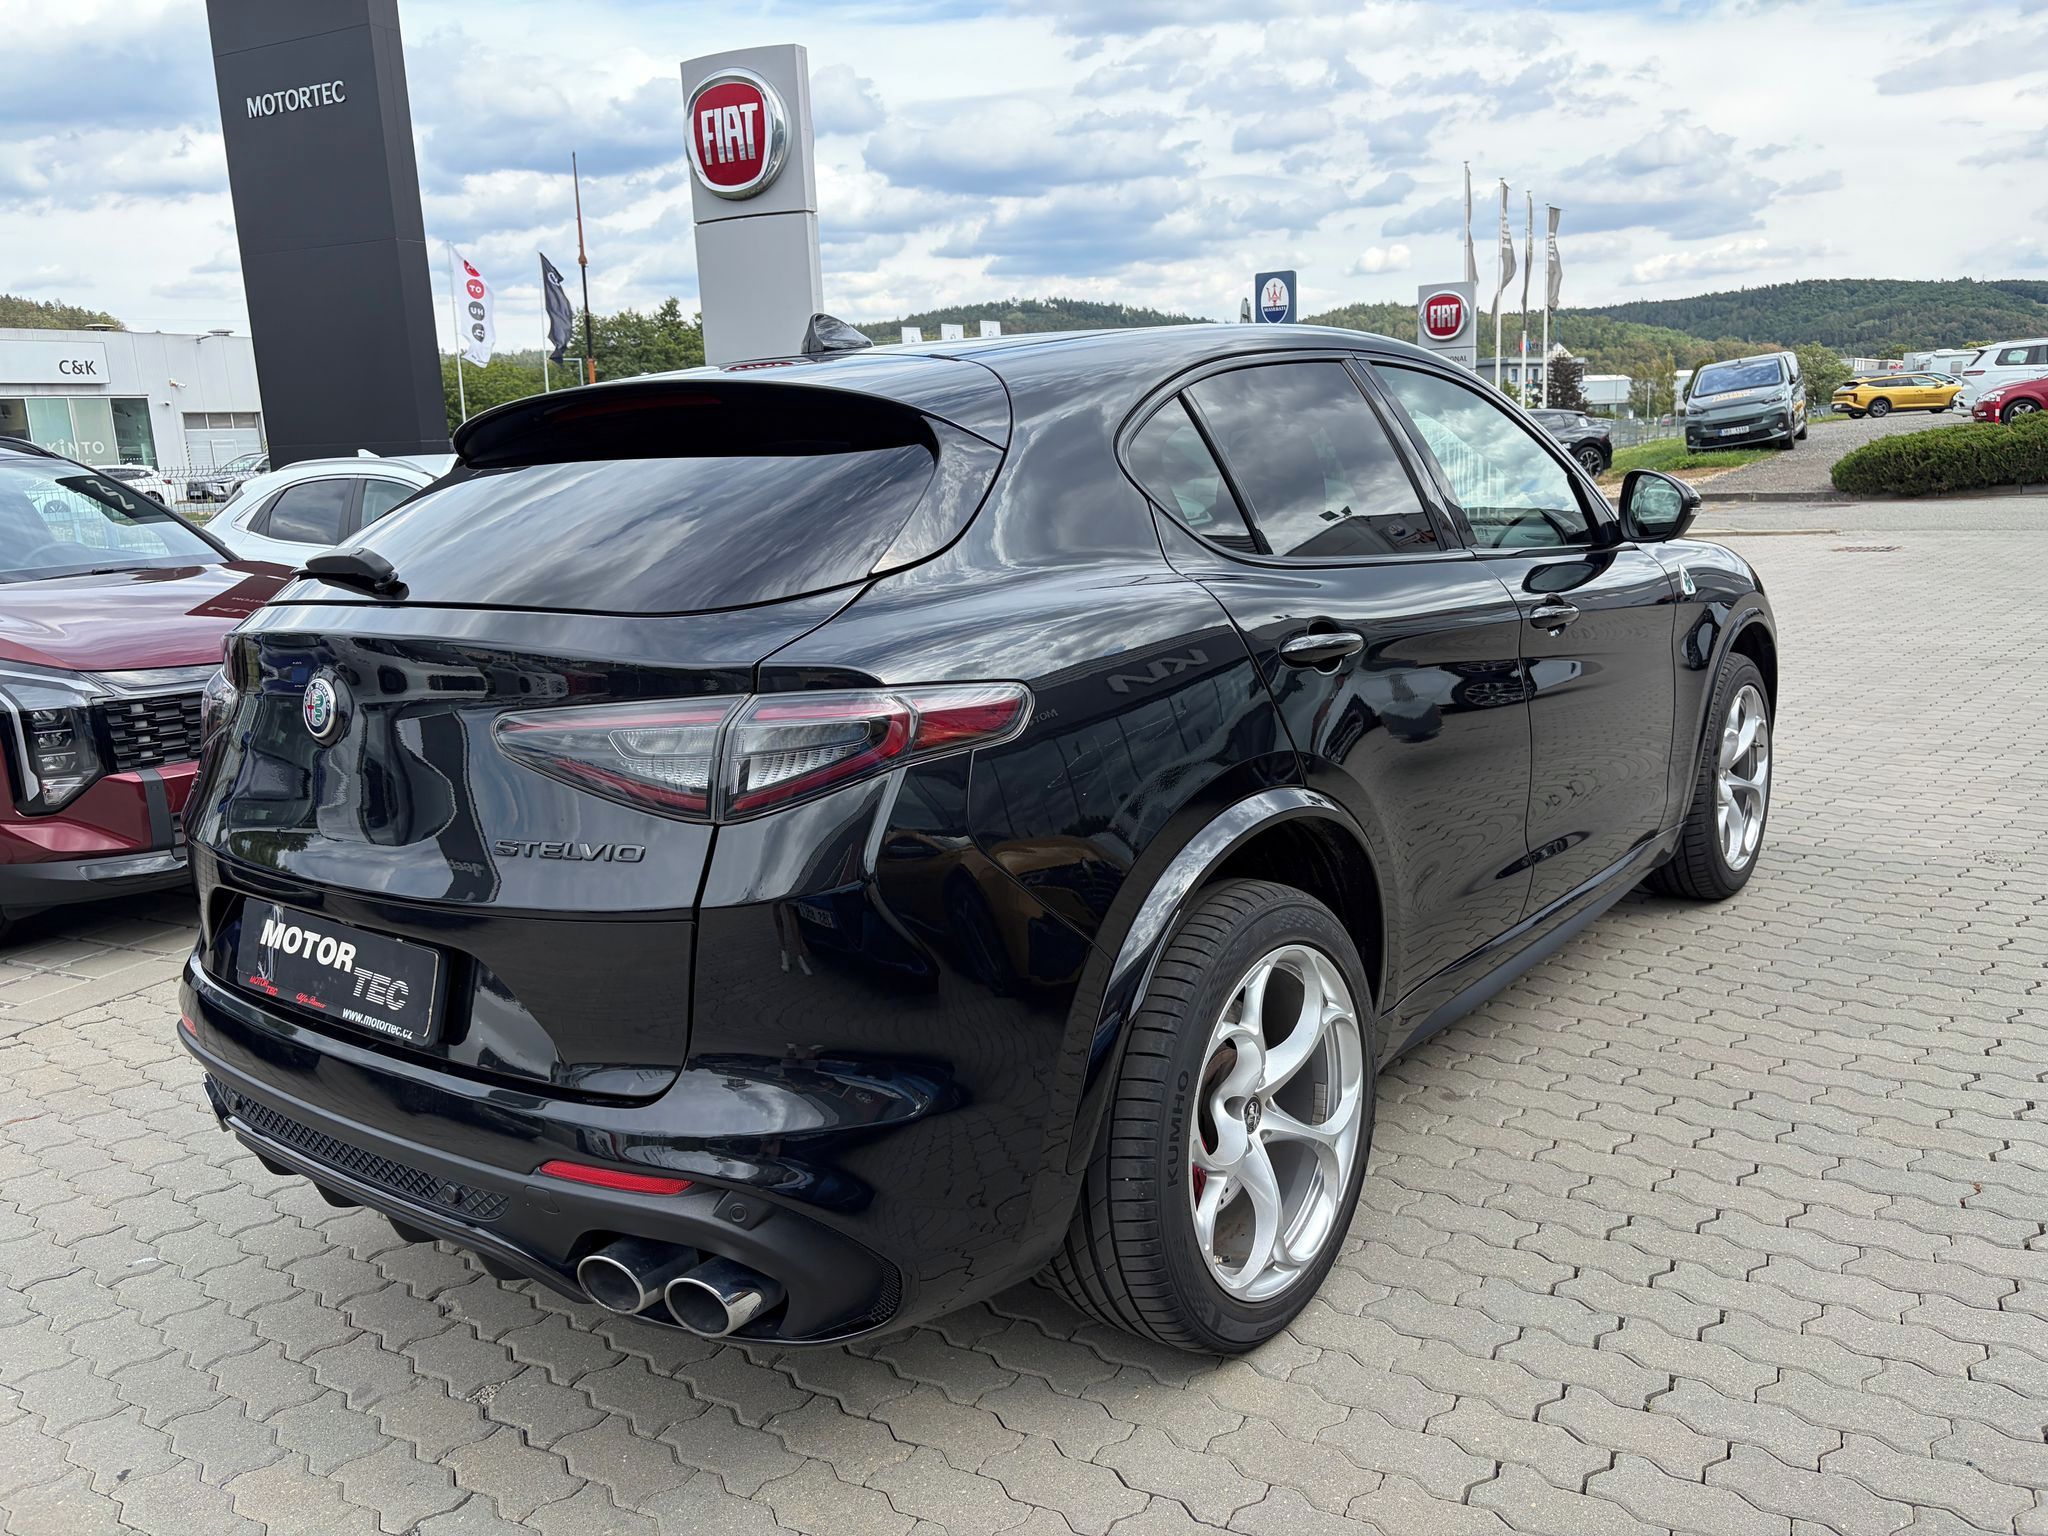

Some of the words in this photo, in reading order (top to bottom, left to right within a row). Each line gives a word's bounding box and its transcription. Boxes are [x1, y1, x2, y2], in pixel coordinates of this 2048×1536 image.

[246, 80, 346, 118] MOTORTEC
[701, 102, 759, 166] FIAT
[1429, 303, 1459, 328] FIAT
[58, 360, 97, 375] C&K
[494, 840, 647, 863] STELVIO
[260, 919, 357, 973] MOTOR
[249, 975, 270, 987] MOTOR
[353, 967, 409, 1011] TEC
[342, 1007, 413, 1040] www.motortec.cz
[1168, 1070, 1189, 1187] KUMHO
